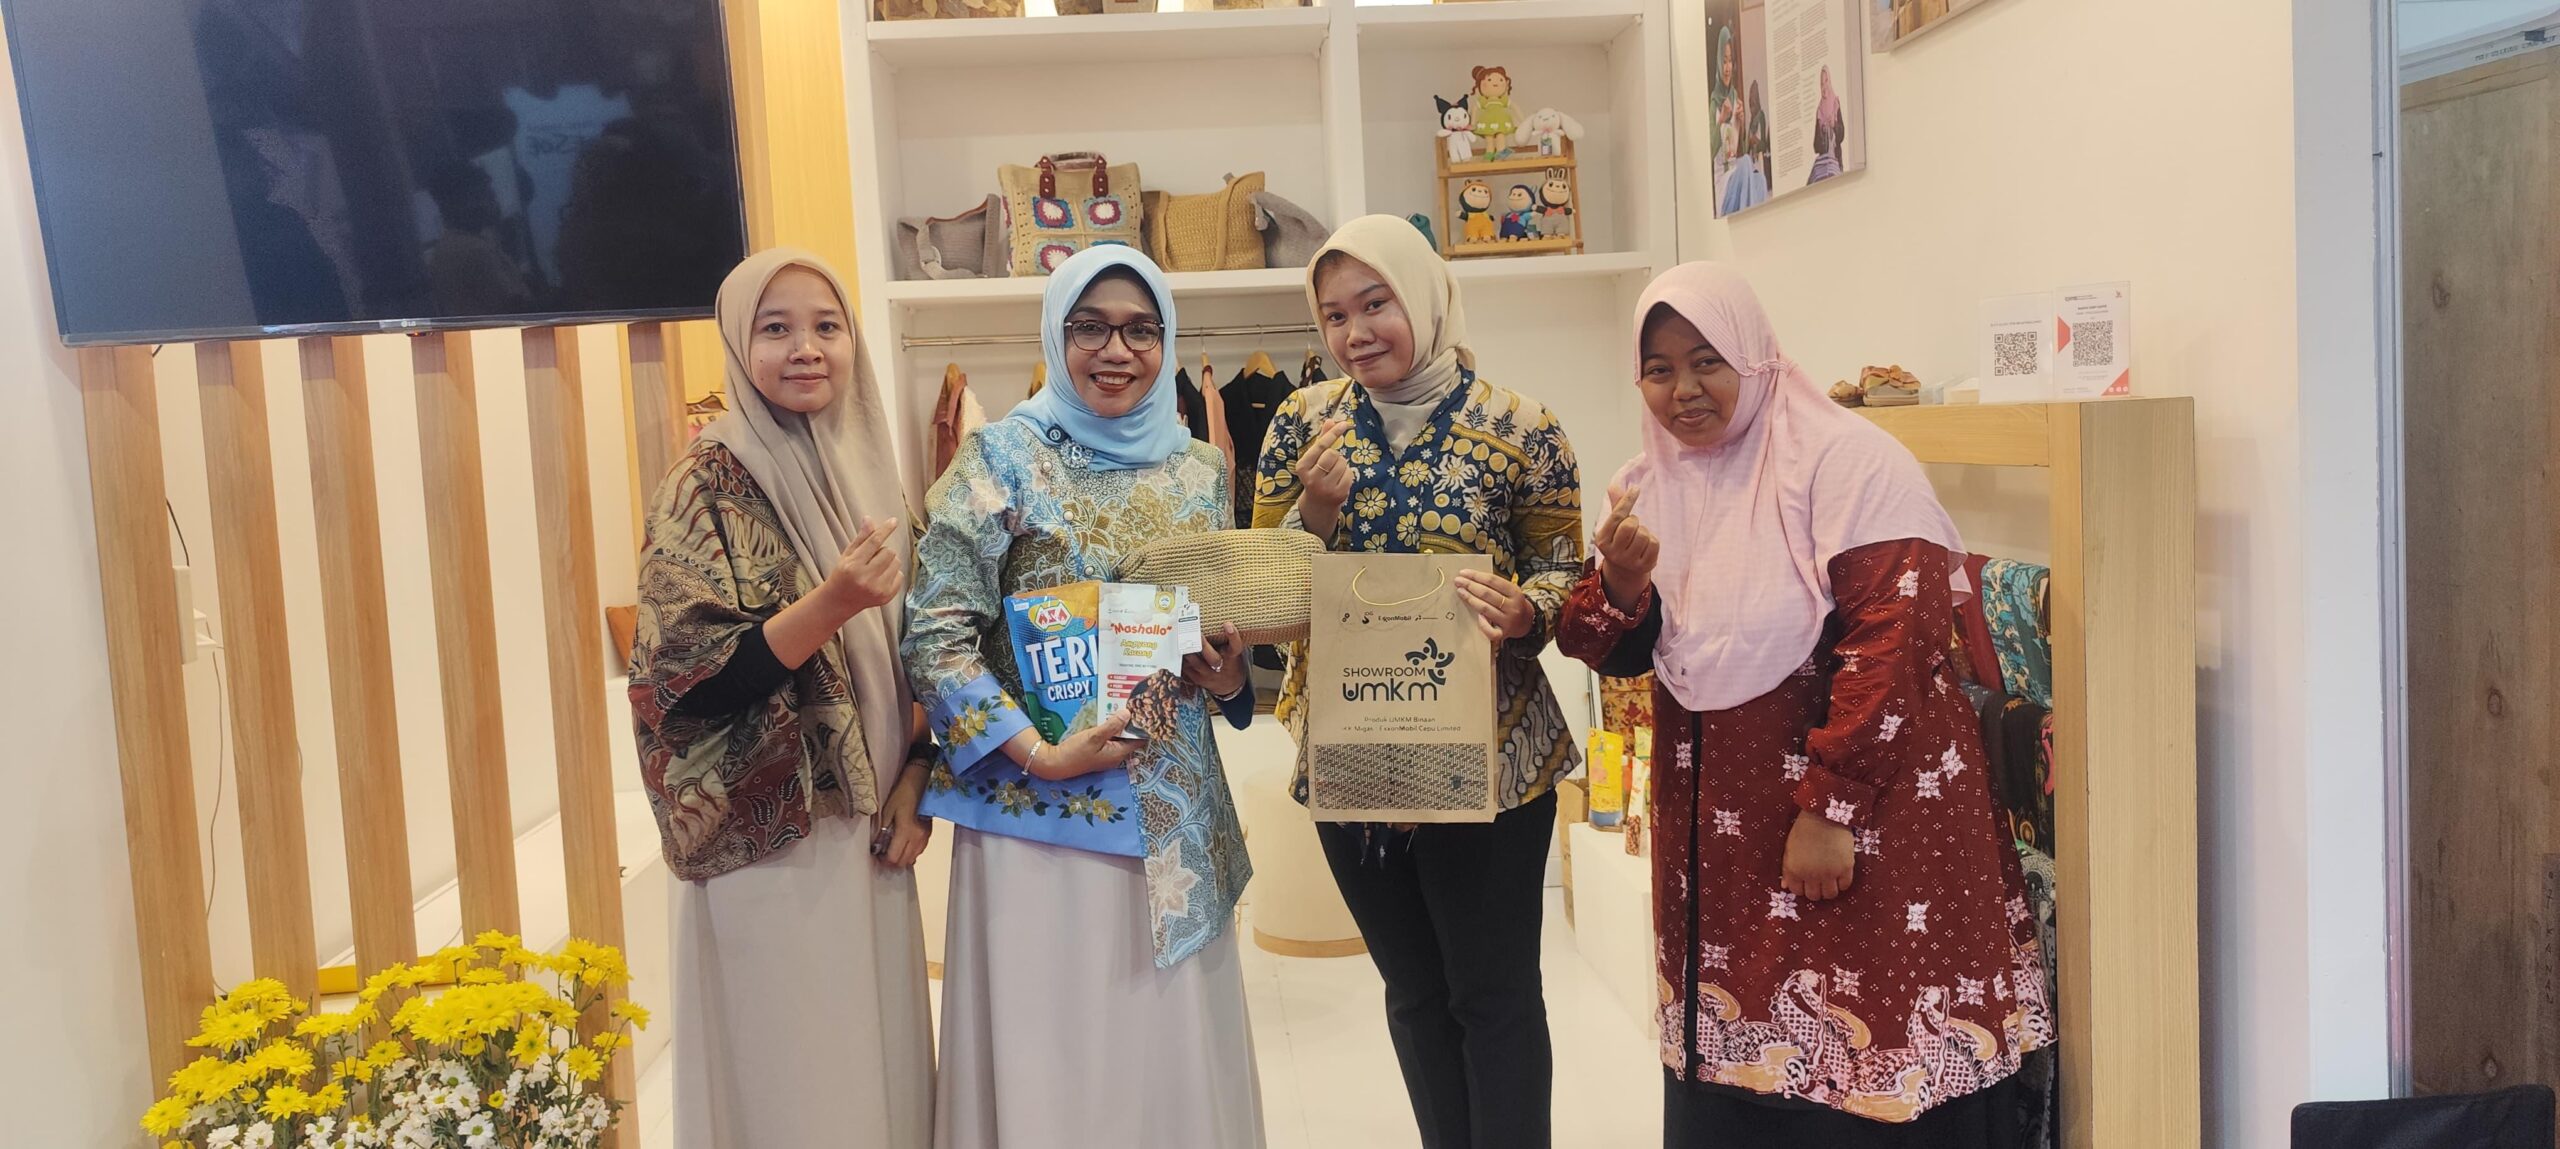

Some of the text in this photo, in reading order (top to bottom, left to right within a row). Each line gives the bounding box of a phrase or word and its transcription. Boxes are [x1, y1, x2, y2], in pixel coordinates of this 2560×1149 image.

[1025, 634, 1098, 684] TERI
[1343, 667, 1426, 678] SHOWROOM
[1047, 680, 1092, 702] CRISPY
[1389, 715, 1412, 723] UMKM
